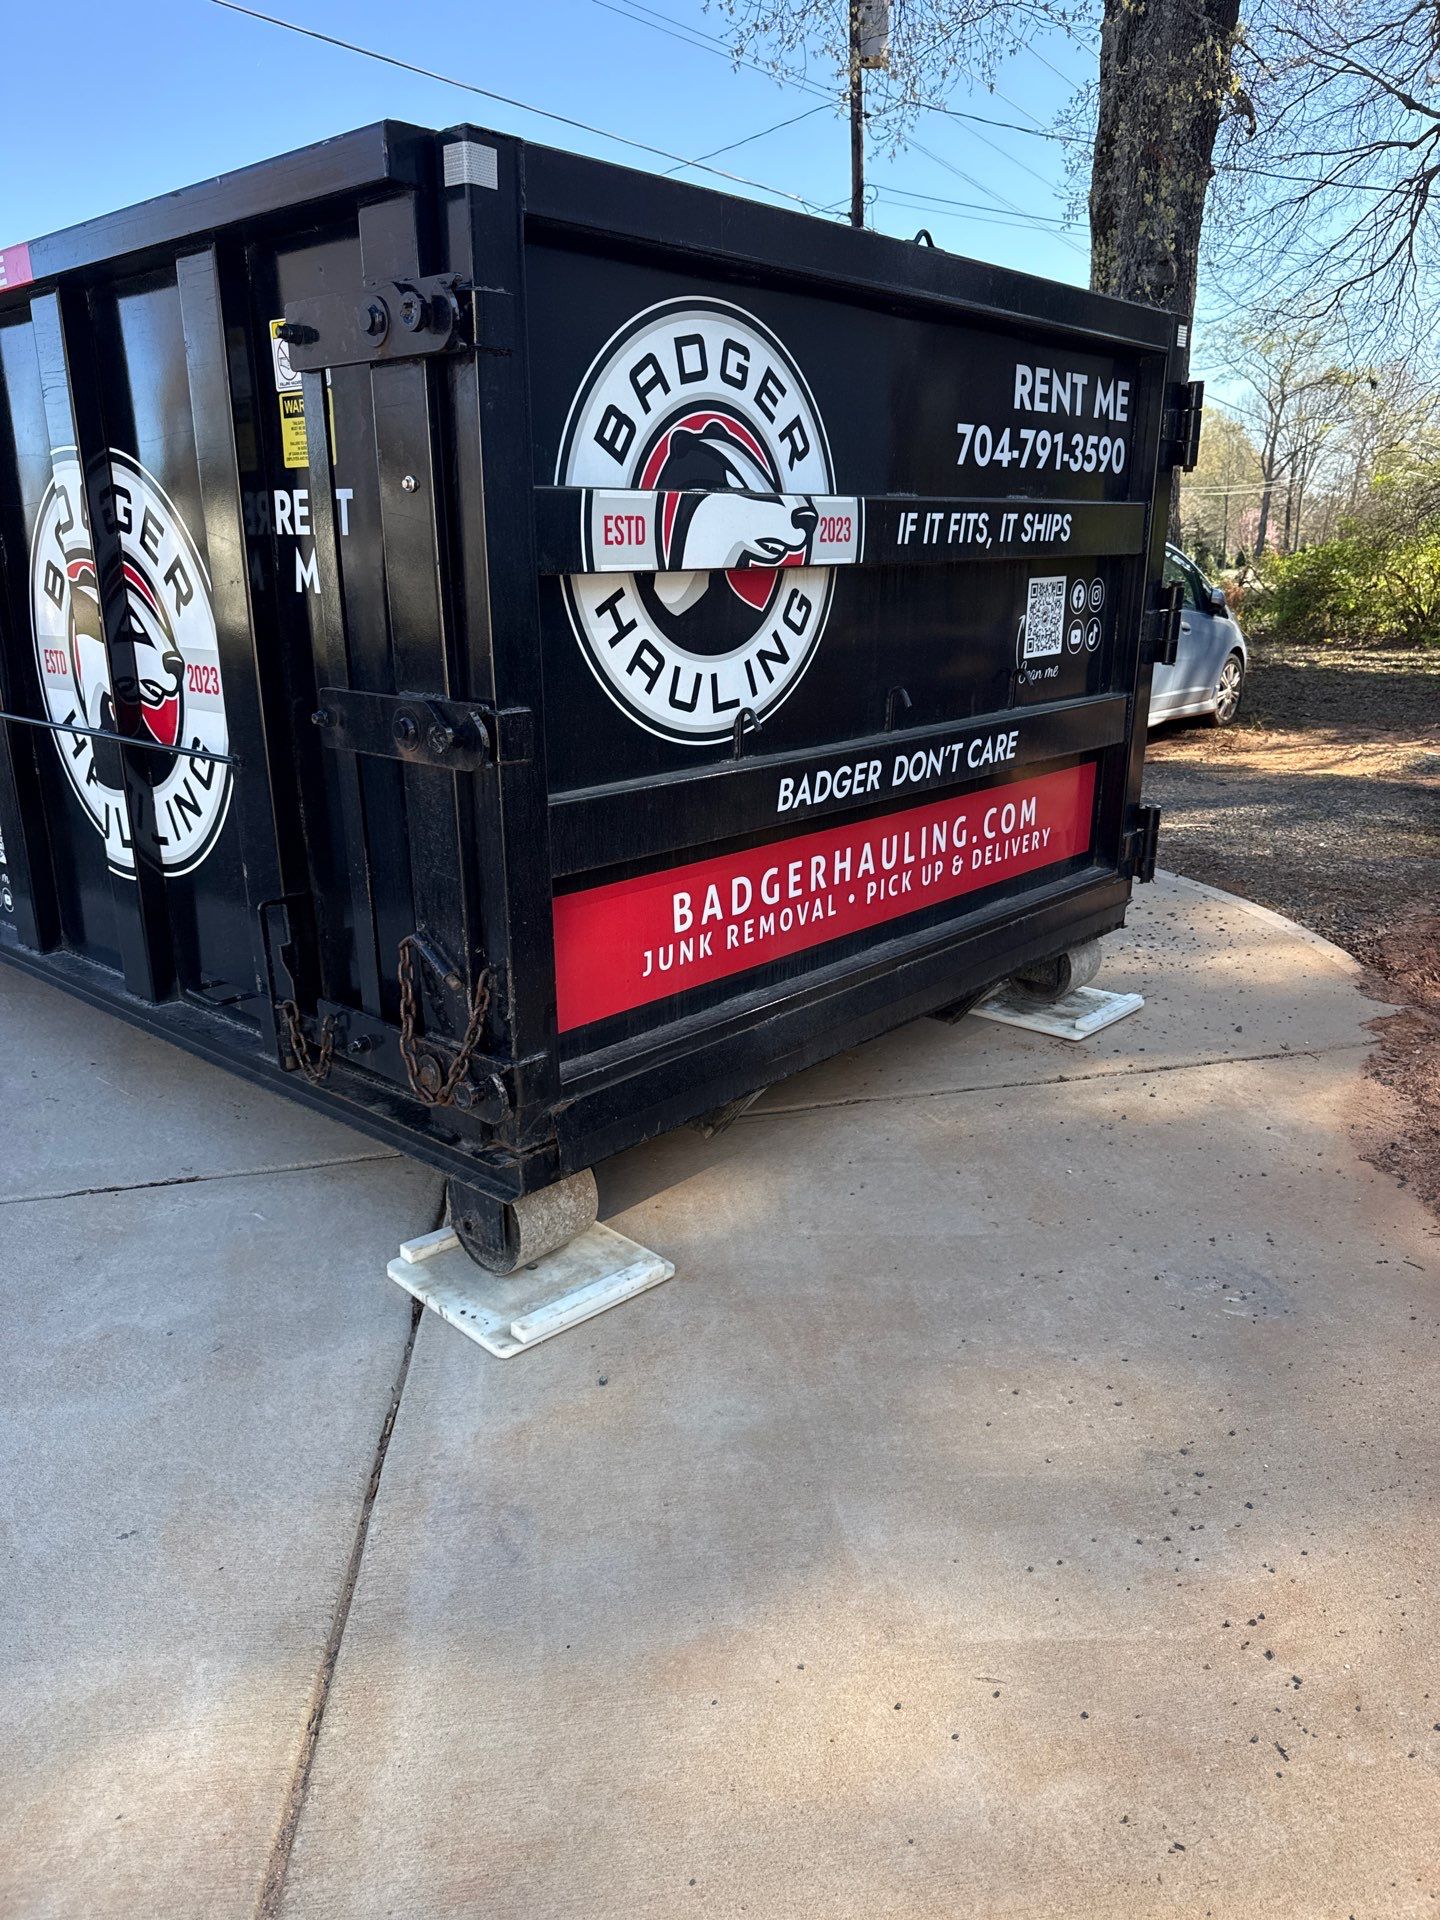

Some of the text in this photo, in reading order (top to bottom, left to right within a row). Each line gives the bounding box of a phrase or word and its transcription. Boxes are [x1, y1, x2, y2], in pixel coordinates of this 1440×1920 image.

[593, 333, 811, 472] BADGER
[1013, 363, 1130, 422] RENT ME
[956, 423, 1126, 474] 704-791-3590
[273, 488, 354, 536] RET
[603, 515, 646, 546] ESTD
[819, 516, 852, 543] 2023
[897, 512, 1073, 550] IF IT FITS, IT SHIPS
[44, 649, 67, 675] ESTD
[594, 587, 813, 714] HAULING
[1044, 665, 1059, 679] me
[187, 664, 220, 695] 2023
[776, 730, 1020, 813] BADGER DON'T CARE
[672, 796, 1037, 933] BADGERHAULING.COM
[642, 827, 1051, 977] JUNK REMOVAL PICK UP & DELIVERY
